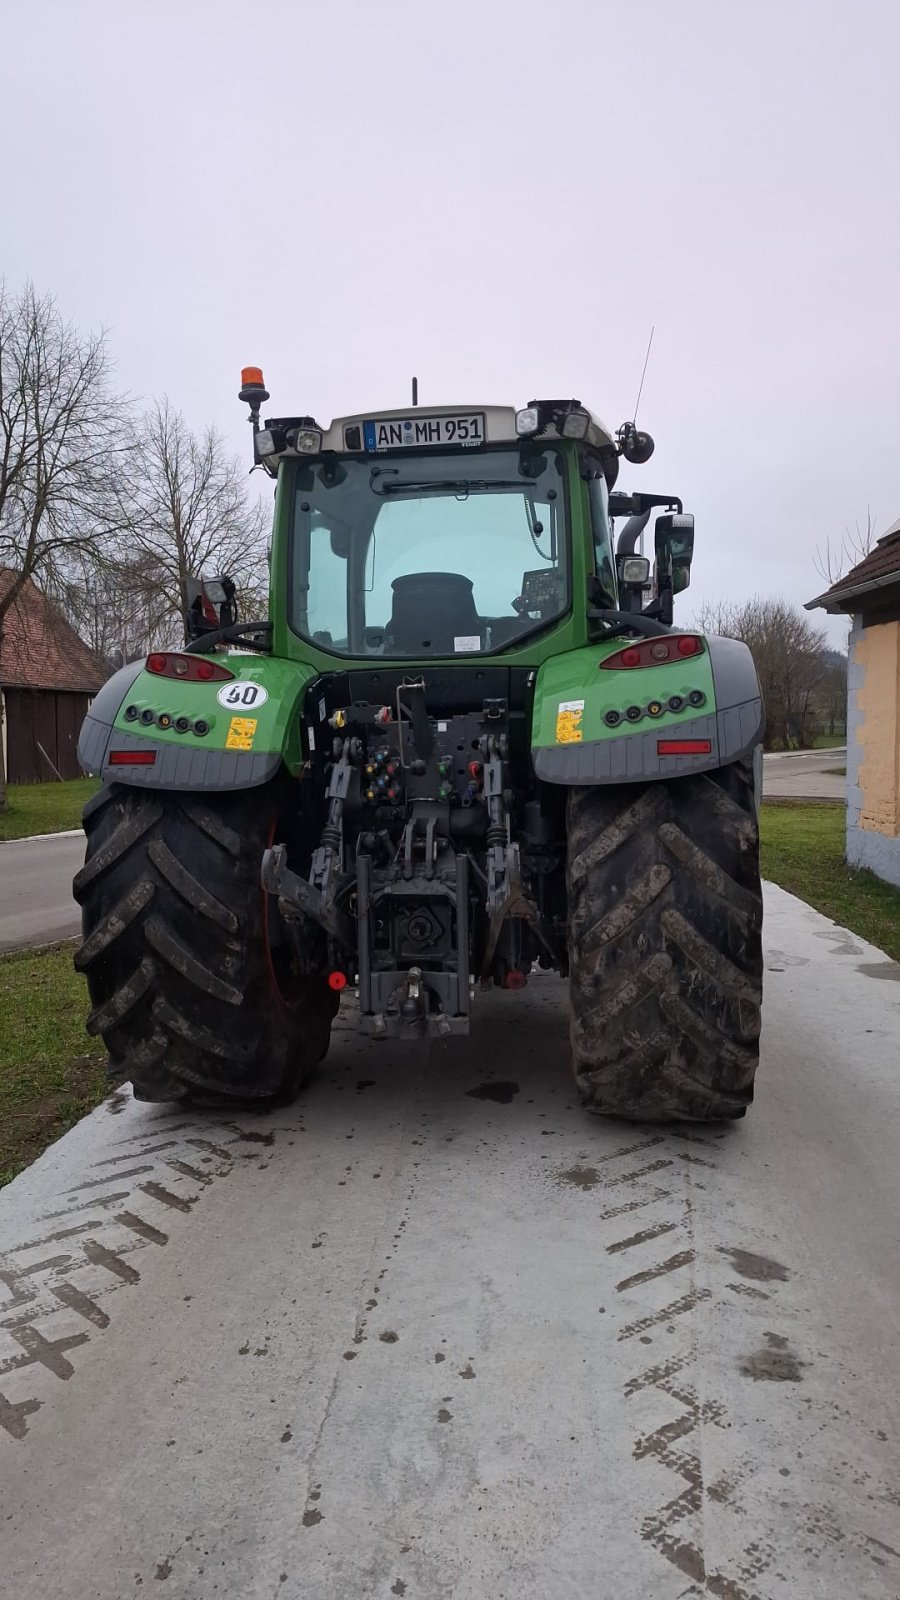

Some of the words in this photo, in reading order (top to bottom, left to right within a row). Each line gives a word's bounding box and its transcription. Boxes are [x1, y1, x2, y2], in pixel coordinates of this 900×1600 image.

[378, 424, 403, 445] AN
[415, 421, 441, 442] MH
[445, 419, 482, 441] 951
